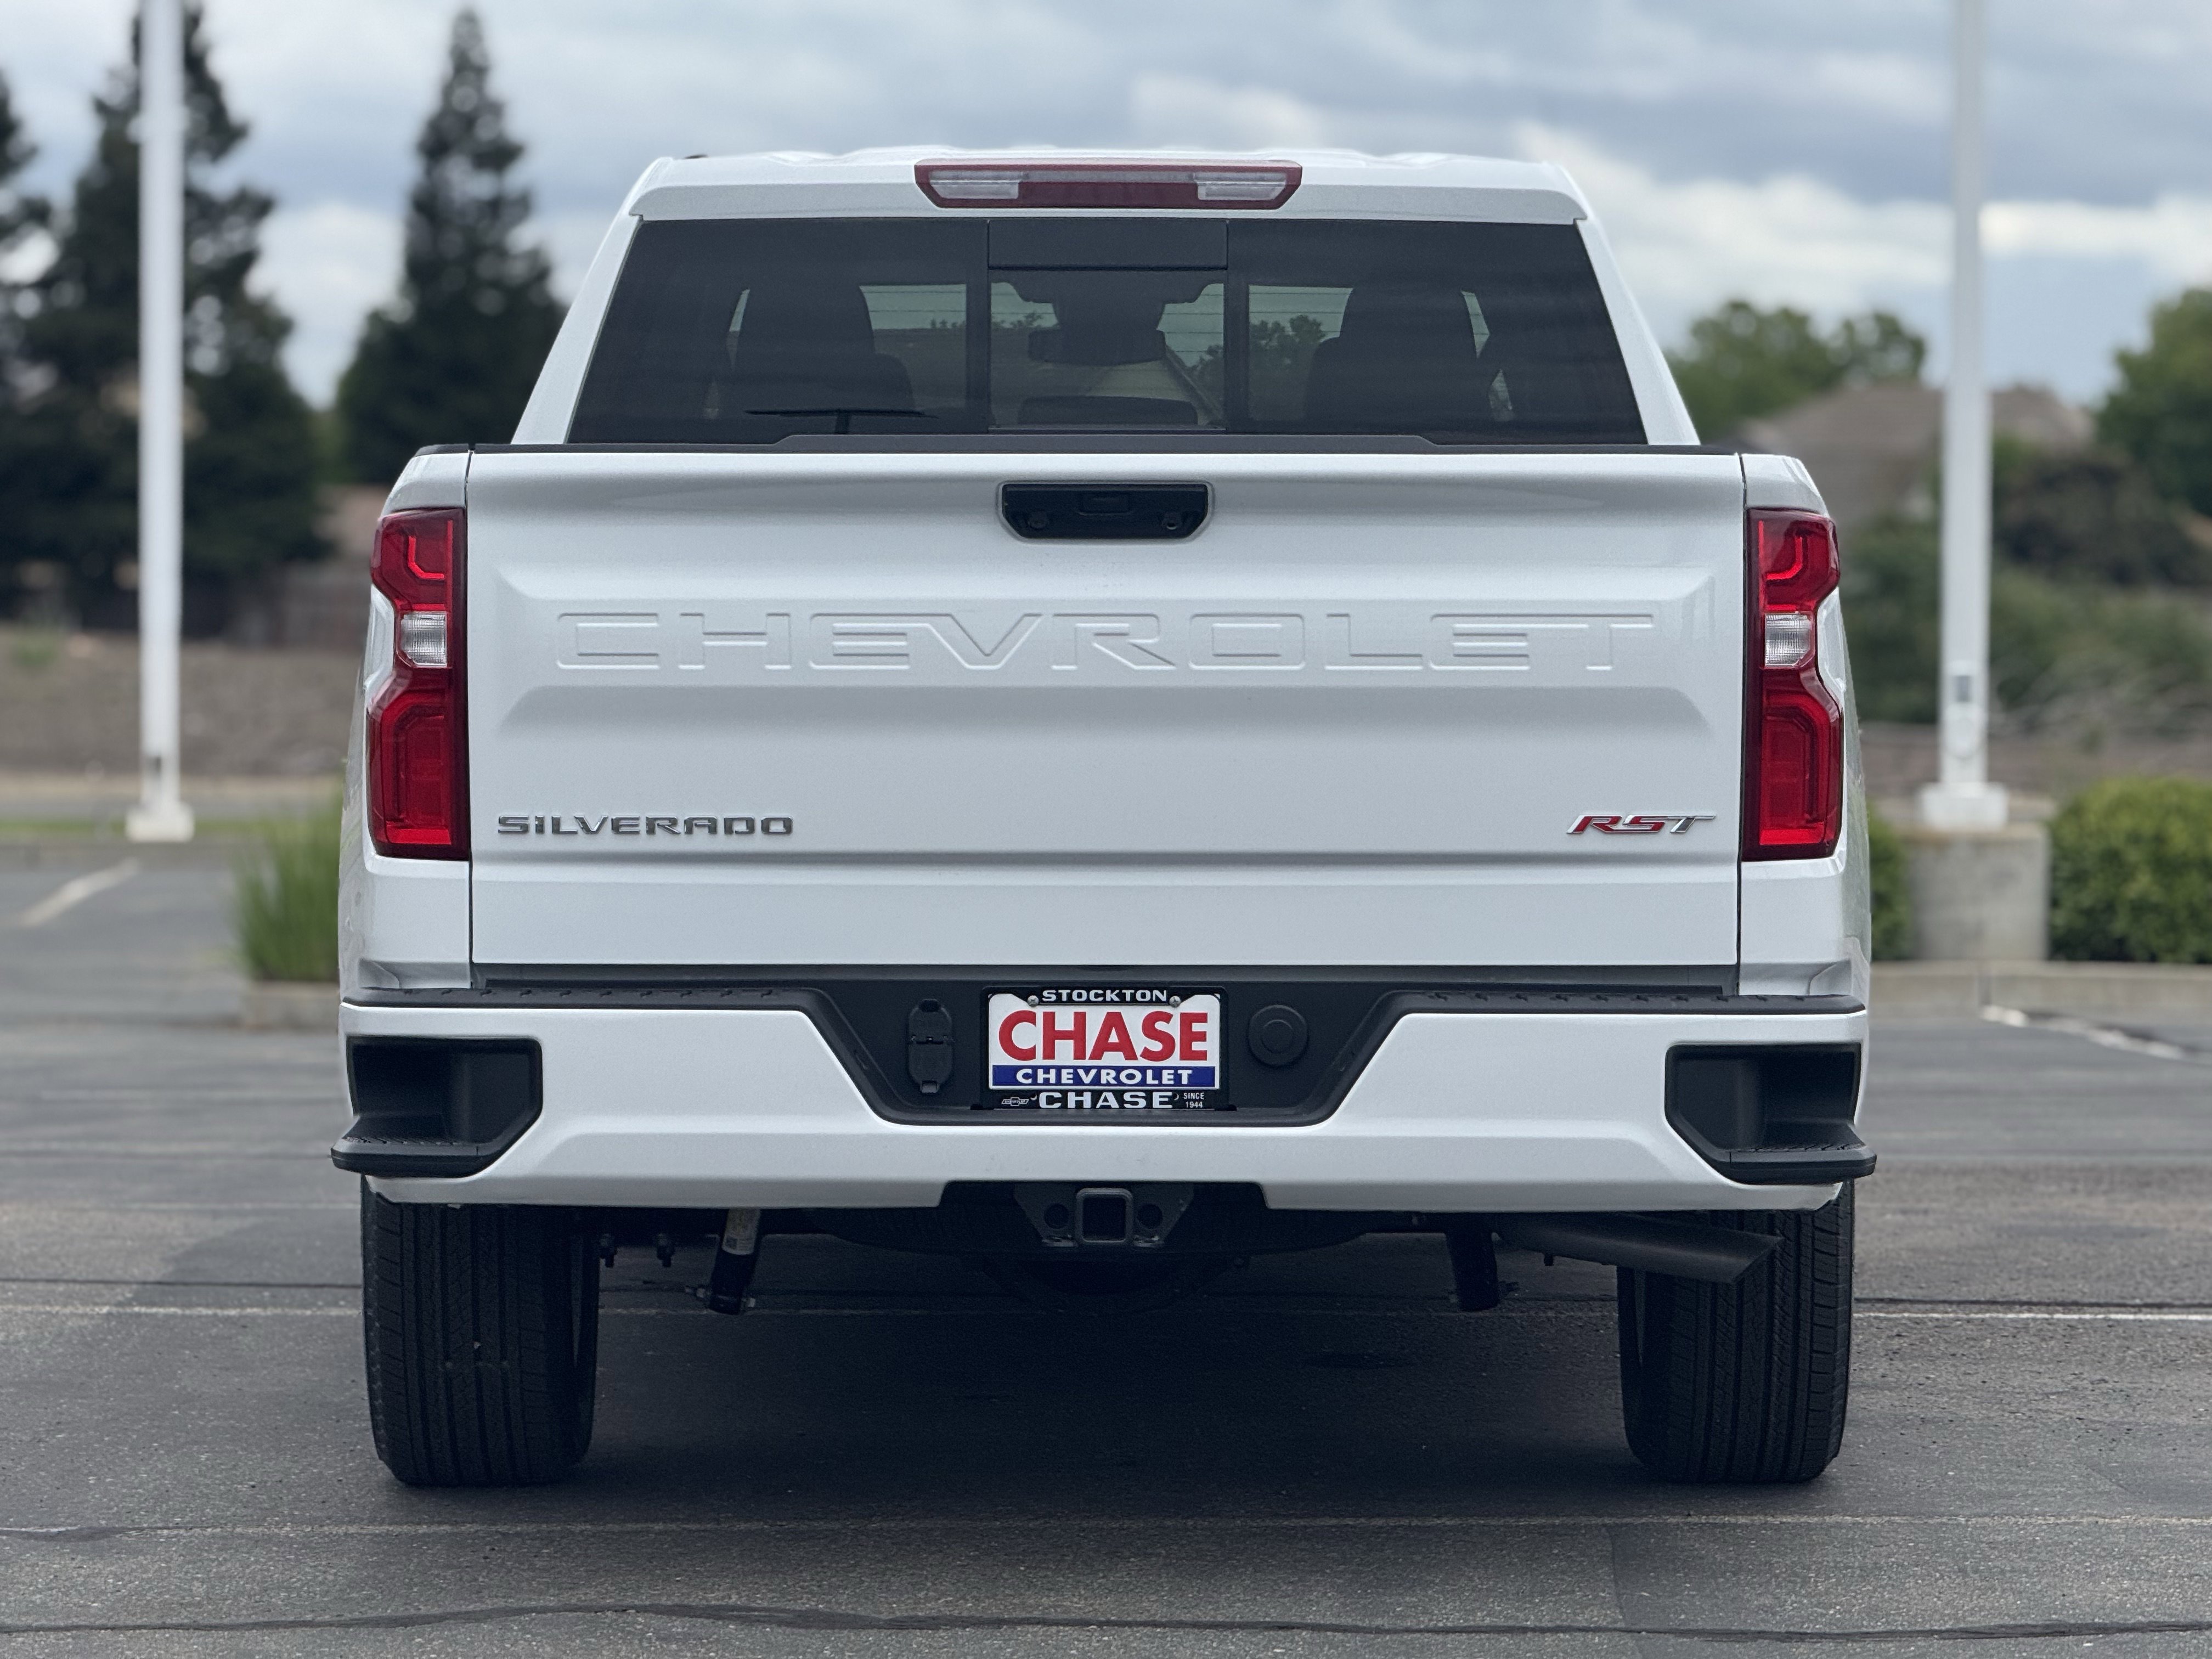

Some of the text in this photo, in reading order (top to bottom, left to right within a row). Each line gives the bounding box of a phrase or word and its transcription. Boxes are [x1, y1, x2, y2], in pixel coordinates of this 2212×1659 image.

[557, 612, 1654, 670] CHEVROLET
[498, 815, 793, 835] SILVERADO
[1566, 814, 1717, 834] RST
[1042, 990, 1167, 1001] STOCKTON
[998, 1010, 1207, 1062] CHASE
[1016, 1068, 1192, 1085] CHEVROLET
[1039, 1092, 1173, 1109] CHASE
